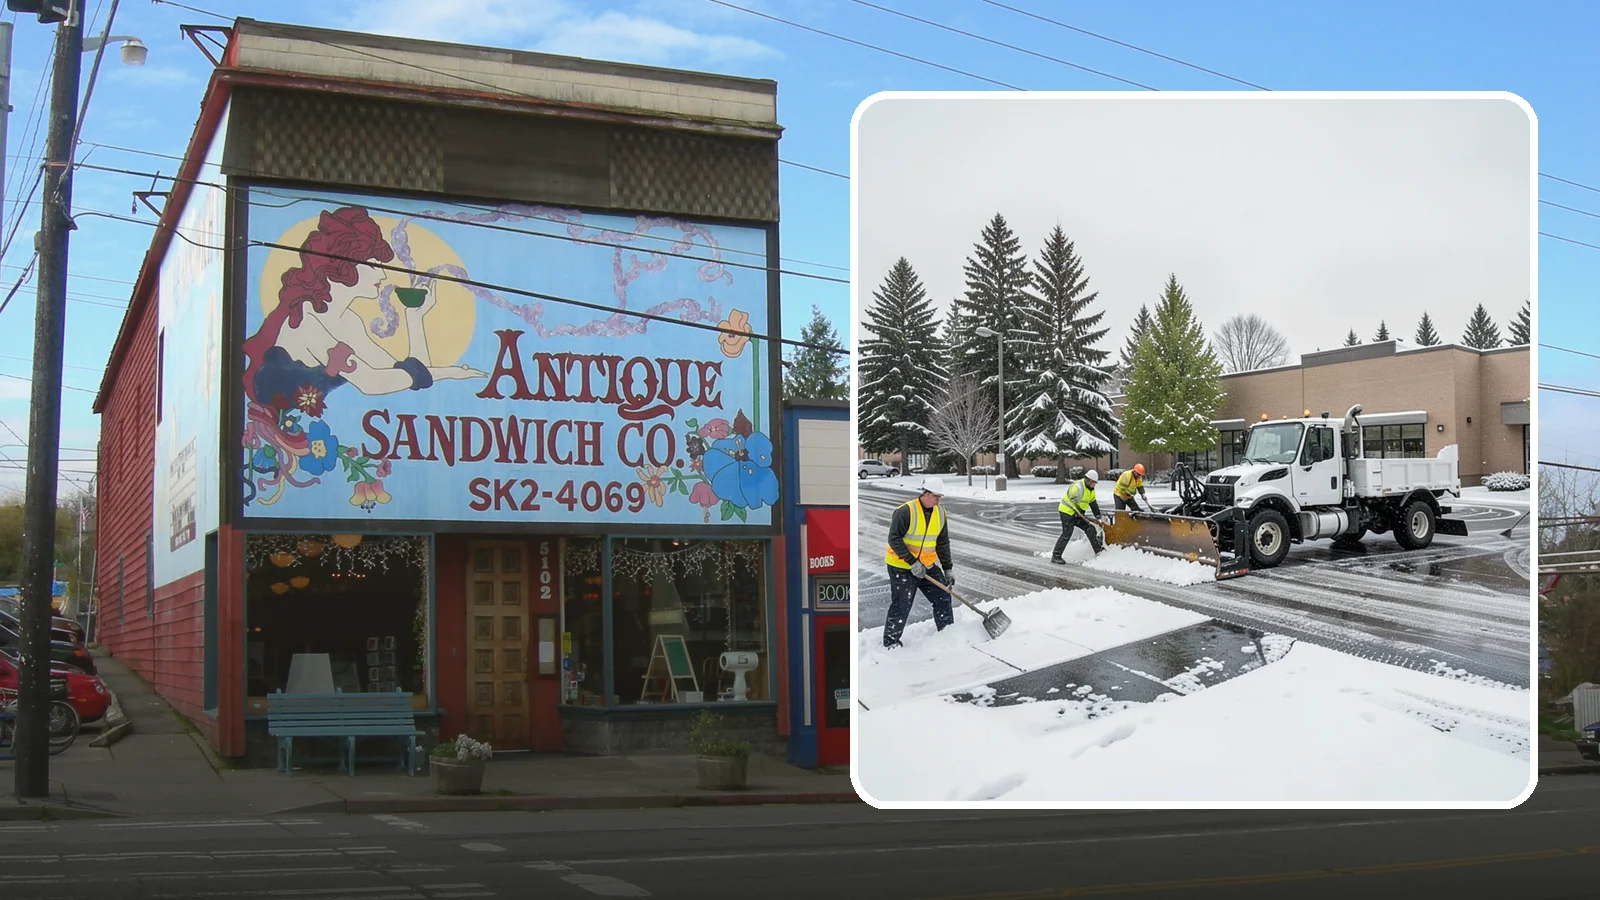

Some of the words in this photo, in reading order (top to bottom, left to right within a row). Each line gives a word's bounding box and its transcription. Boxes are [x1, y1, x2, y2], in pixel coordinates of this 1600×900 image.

[476, 329, 723, 421] ANTIQUE
[361, 408, 604, 468] SANDWICH
[617, 421, 685, 469] CO.
[468, 477, 645, 513] SK2-4069
[540, 541, 552, 600] 5102
[809, 555, 835, 569] BOOKS
